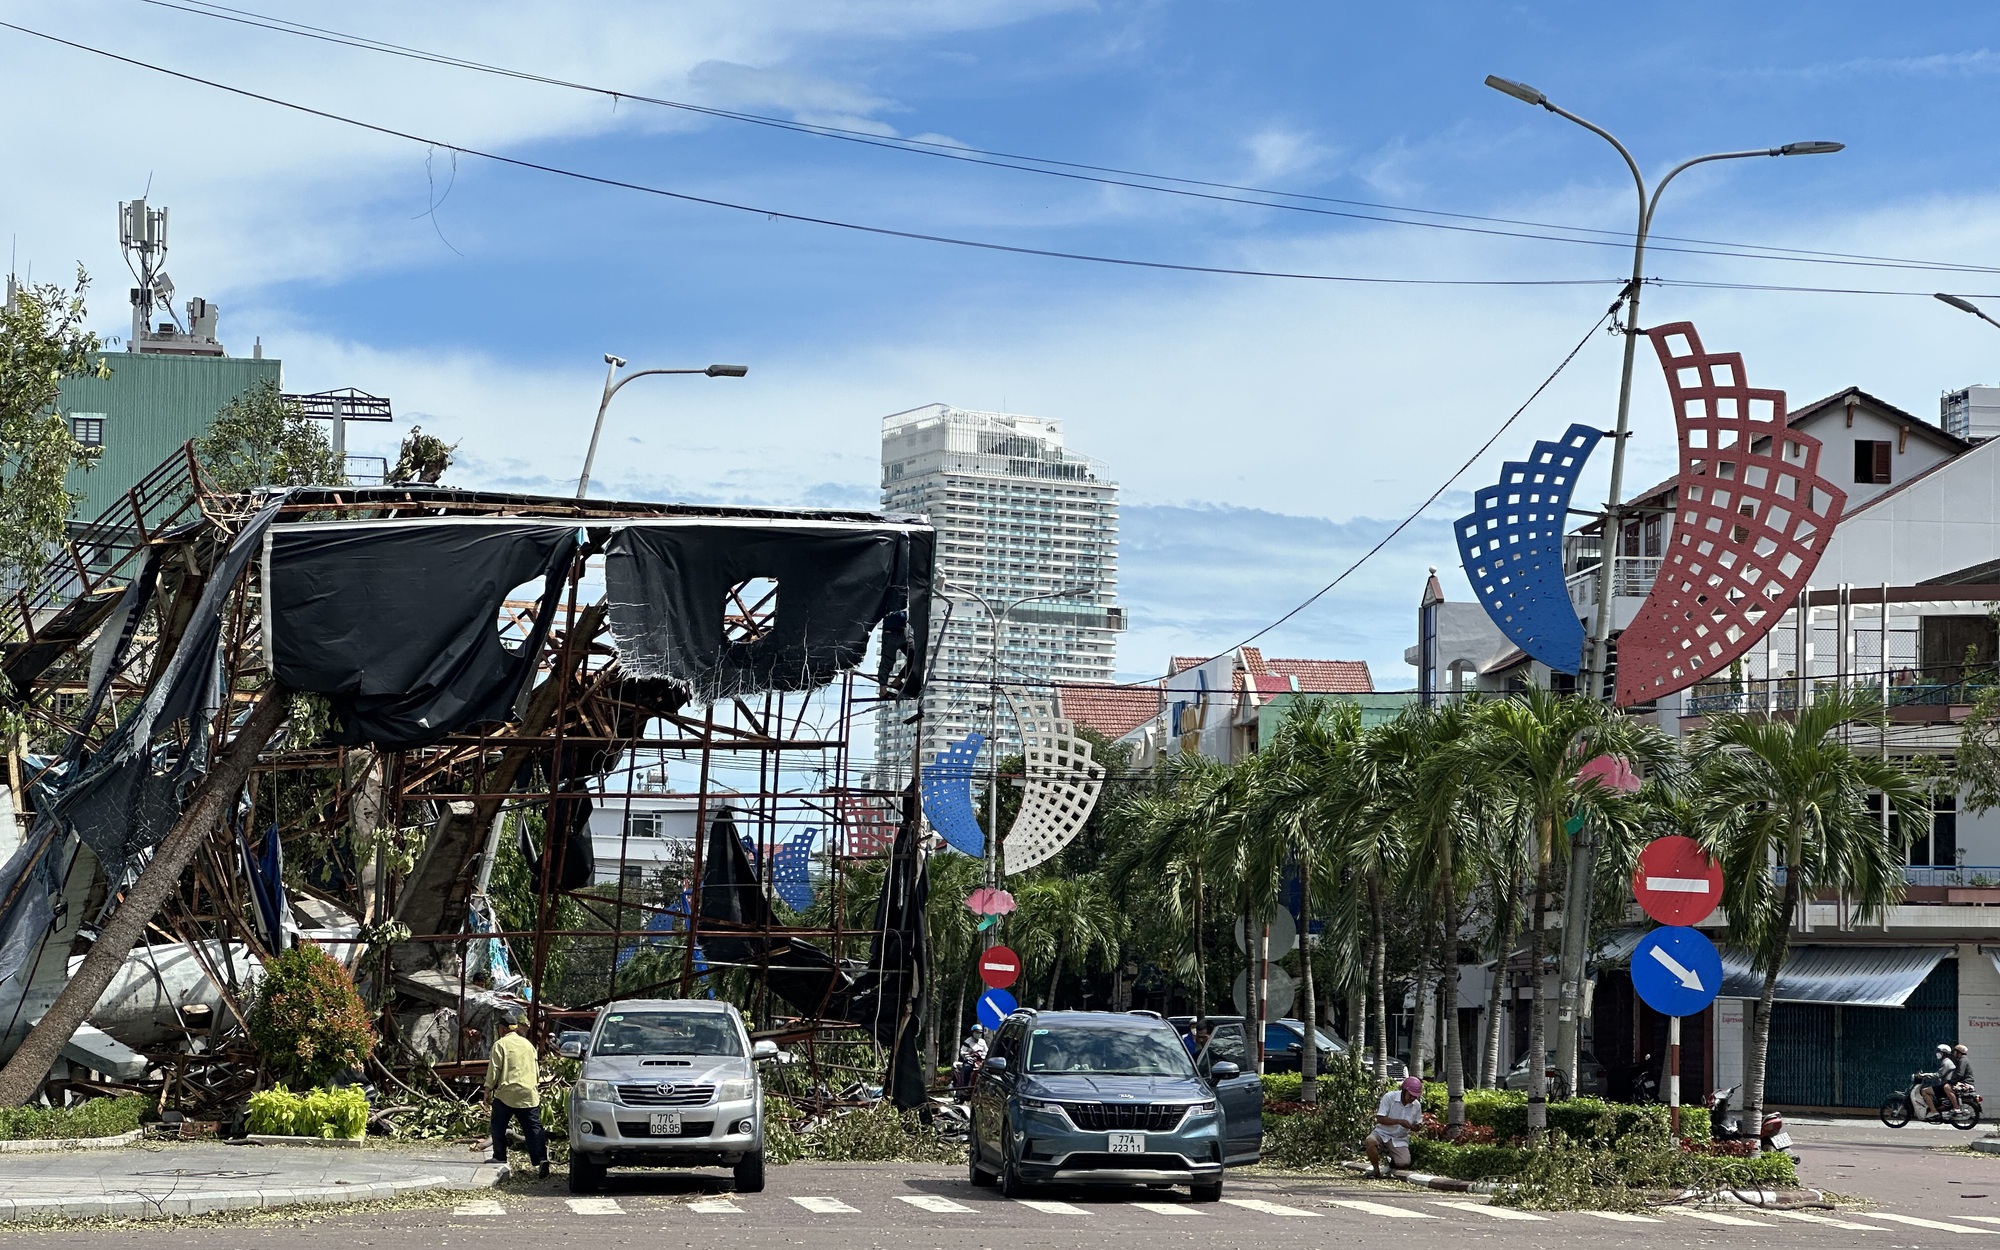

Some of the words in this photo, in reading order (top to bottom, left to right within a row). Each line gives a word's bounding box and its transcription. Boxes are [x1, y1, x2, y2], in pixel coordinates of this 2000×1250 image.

[657, 1114, 674, 1123] 77C
[651, 1124, 680, 1134] 096.95
[1119, 1135, 1135, 1144] 77A
